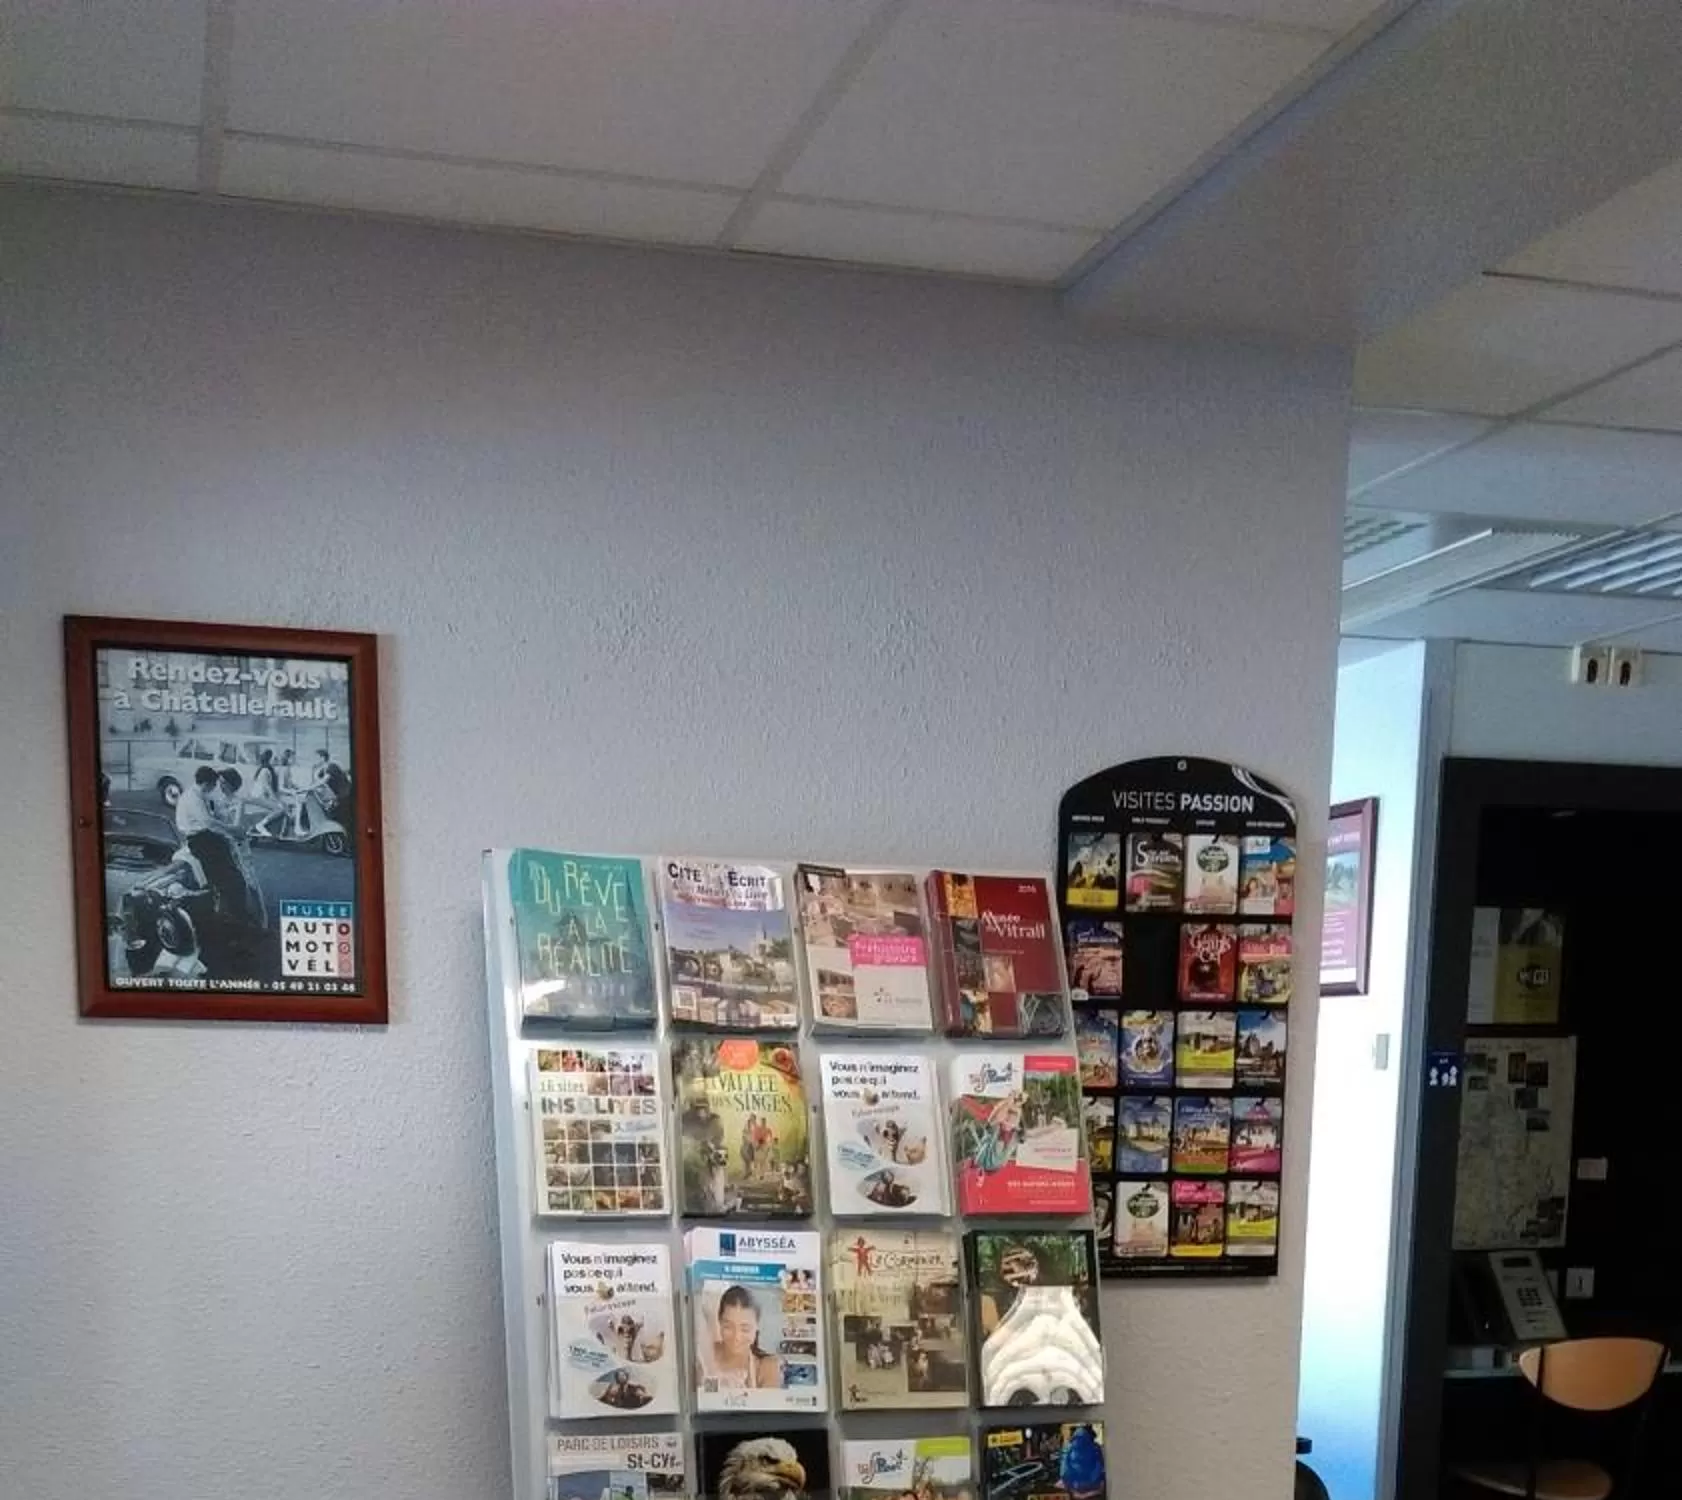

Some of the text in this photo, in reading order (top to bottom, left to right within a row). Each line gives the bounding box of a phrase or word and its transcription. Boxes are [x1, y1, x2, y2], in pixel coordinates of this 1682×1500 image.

[128, 656, 322, 690] Rendez-vous
[114, 687, 340, 720] à Châtellerault
[1112, 790, 1254, 813] VISITES PASSION
[287, 922, 350, 935] AUTO
[995, 918, 1045, 940] Vitrail
[116, 977, 163, 988] OUVERT
[168, 978, 205, 989] TOUTE
[541, 1097, 656, 1115] INSOLITES
[738, 1235, 797, 1249] ABYSSÉA
[561, 1254, 592, 1264] Vous
